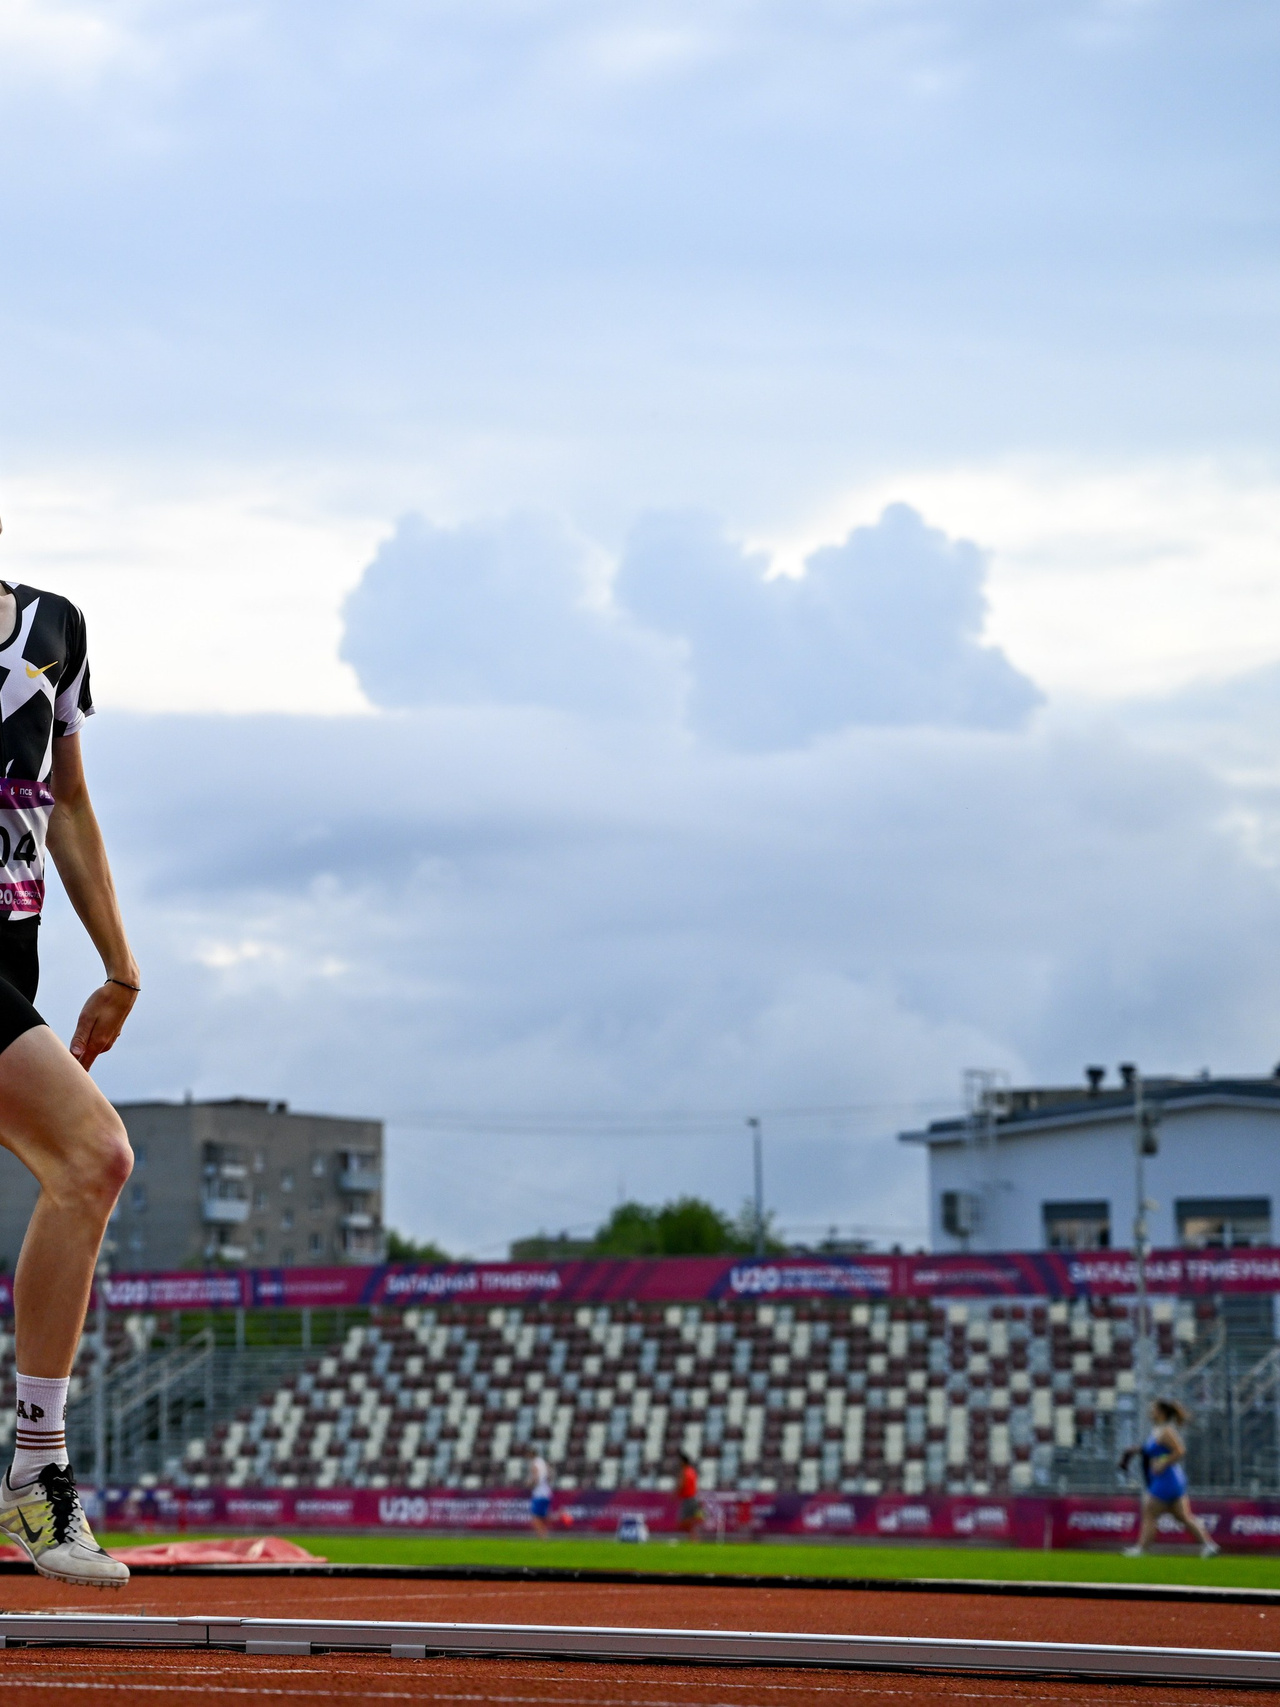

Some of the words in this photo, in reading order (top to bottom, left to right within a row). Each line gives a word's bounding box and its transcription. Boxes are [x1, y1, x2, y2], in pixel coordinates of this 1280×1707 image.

[730, 1266, 781, 1294] U20
[17, 1400, 45, 1423] AP
[378, 1496, 429, 1523] U20
